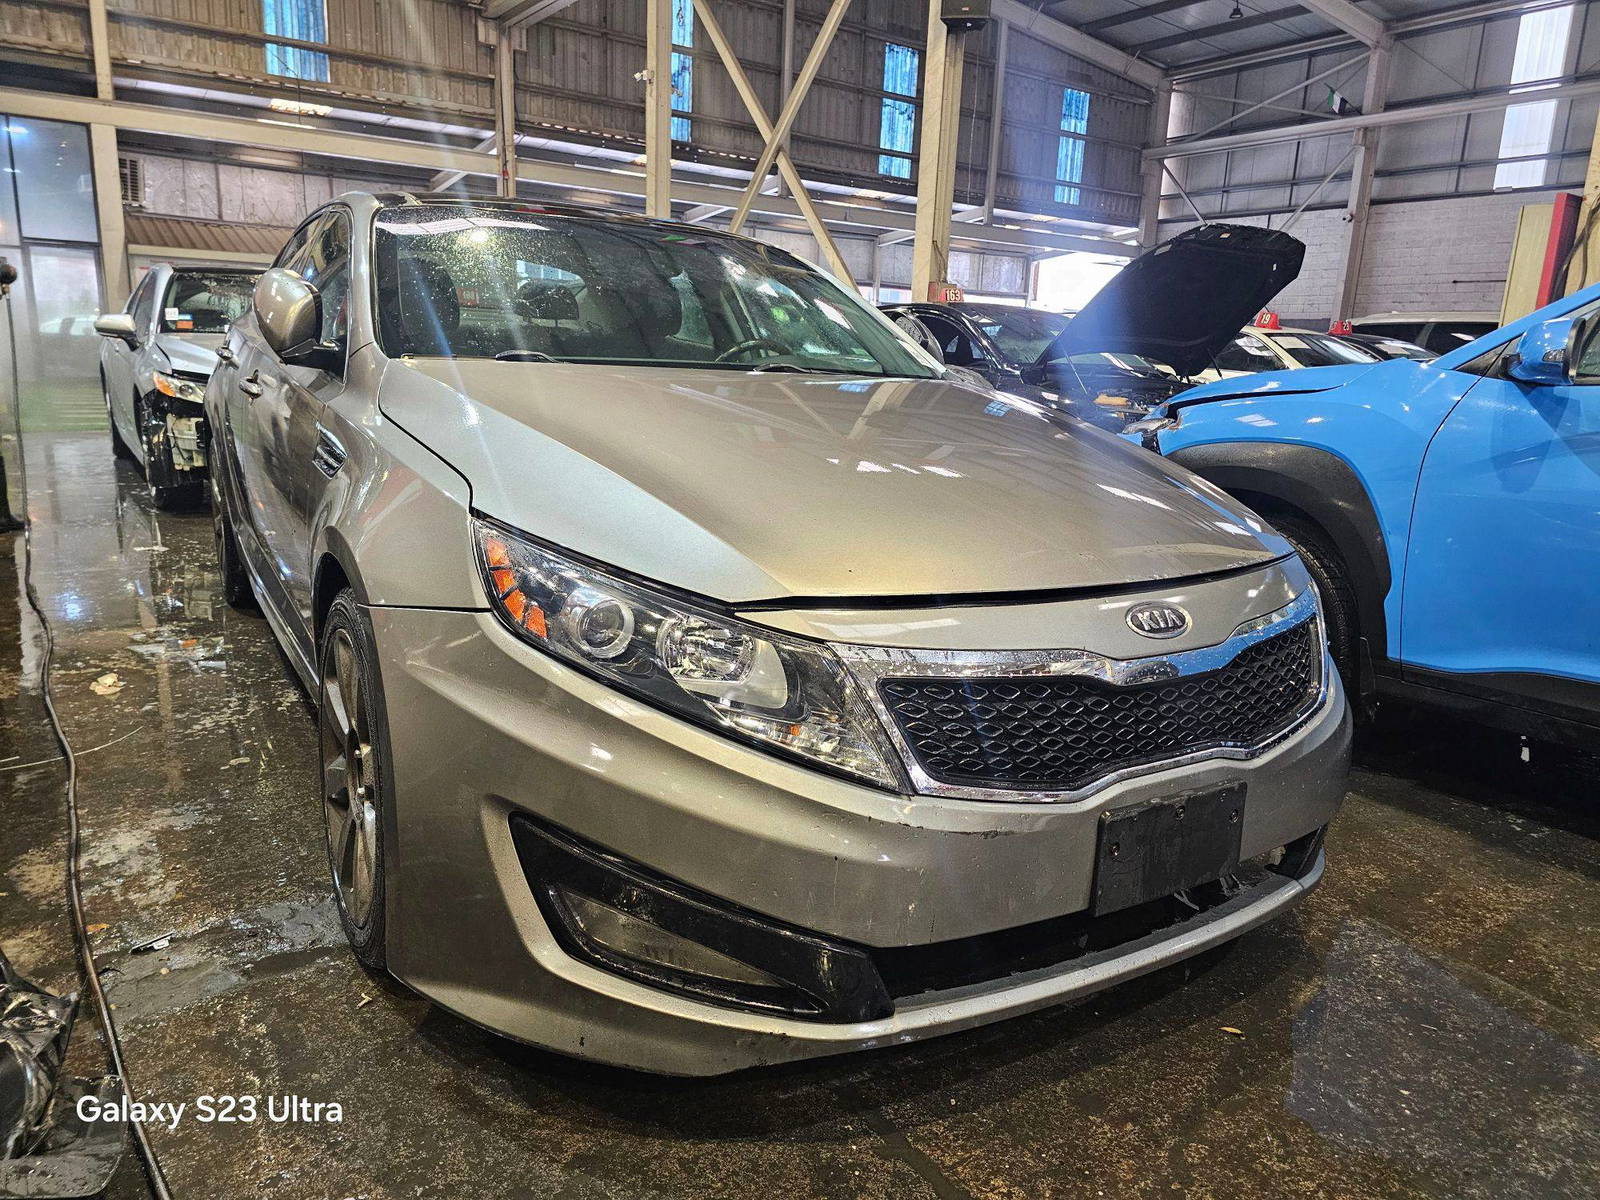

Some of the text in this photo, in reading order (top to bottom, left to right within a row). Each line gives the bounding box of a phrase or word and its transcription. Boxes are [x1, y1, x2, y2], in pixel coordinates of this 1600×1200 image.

[945, 289, 961, 301] 163
[1261, 312, 1271, 324] 19
[1136, 608, 1183, 631] KIA
